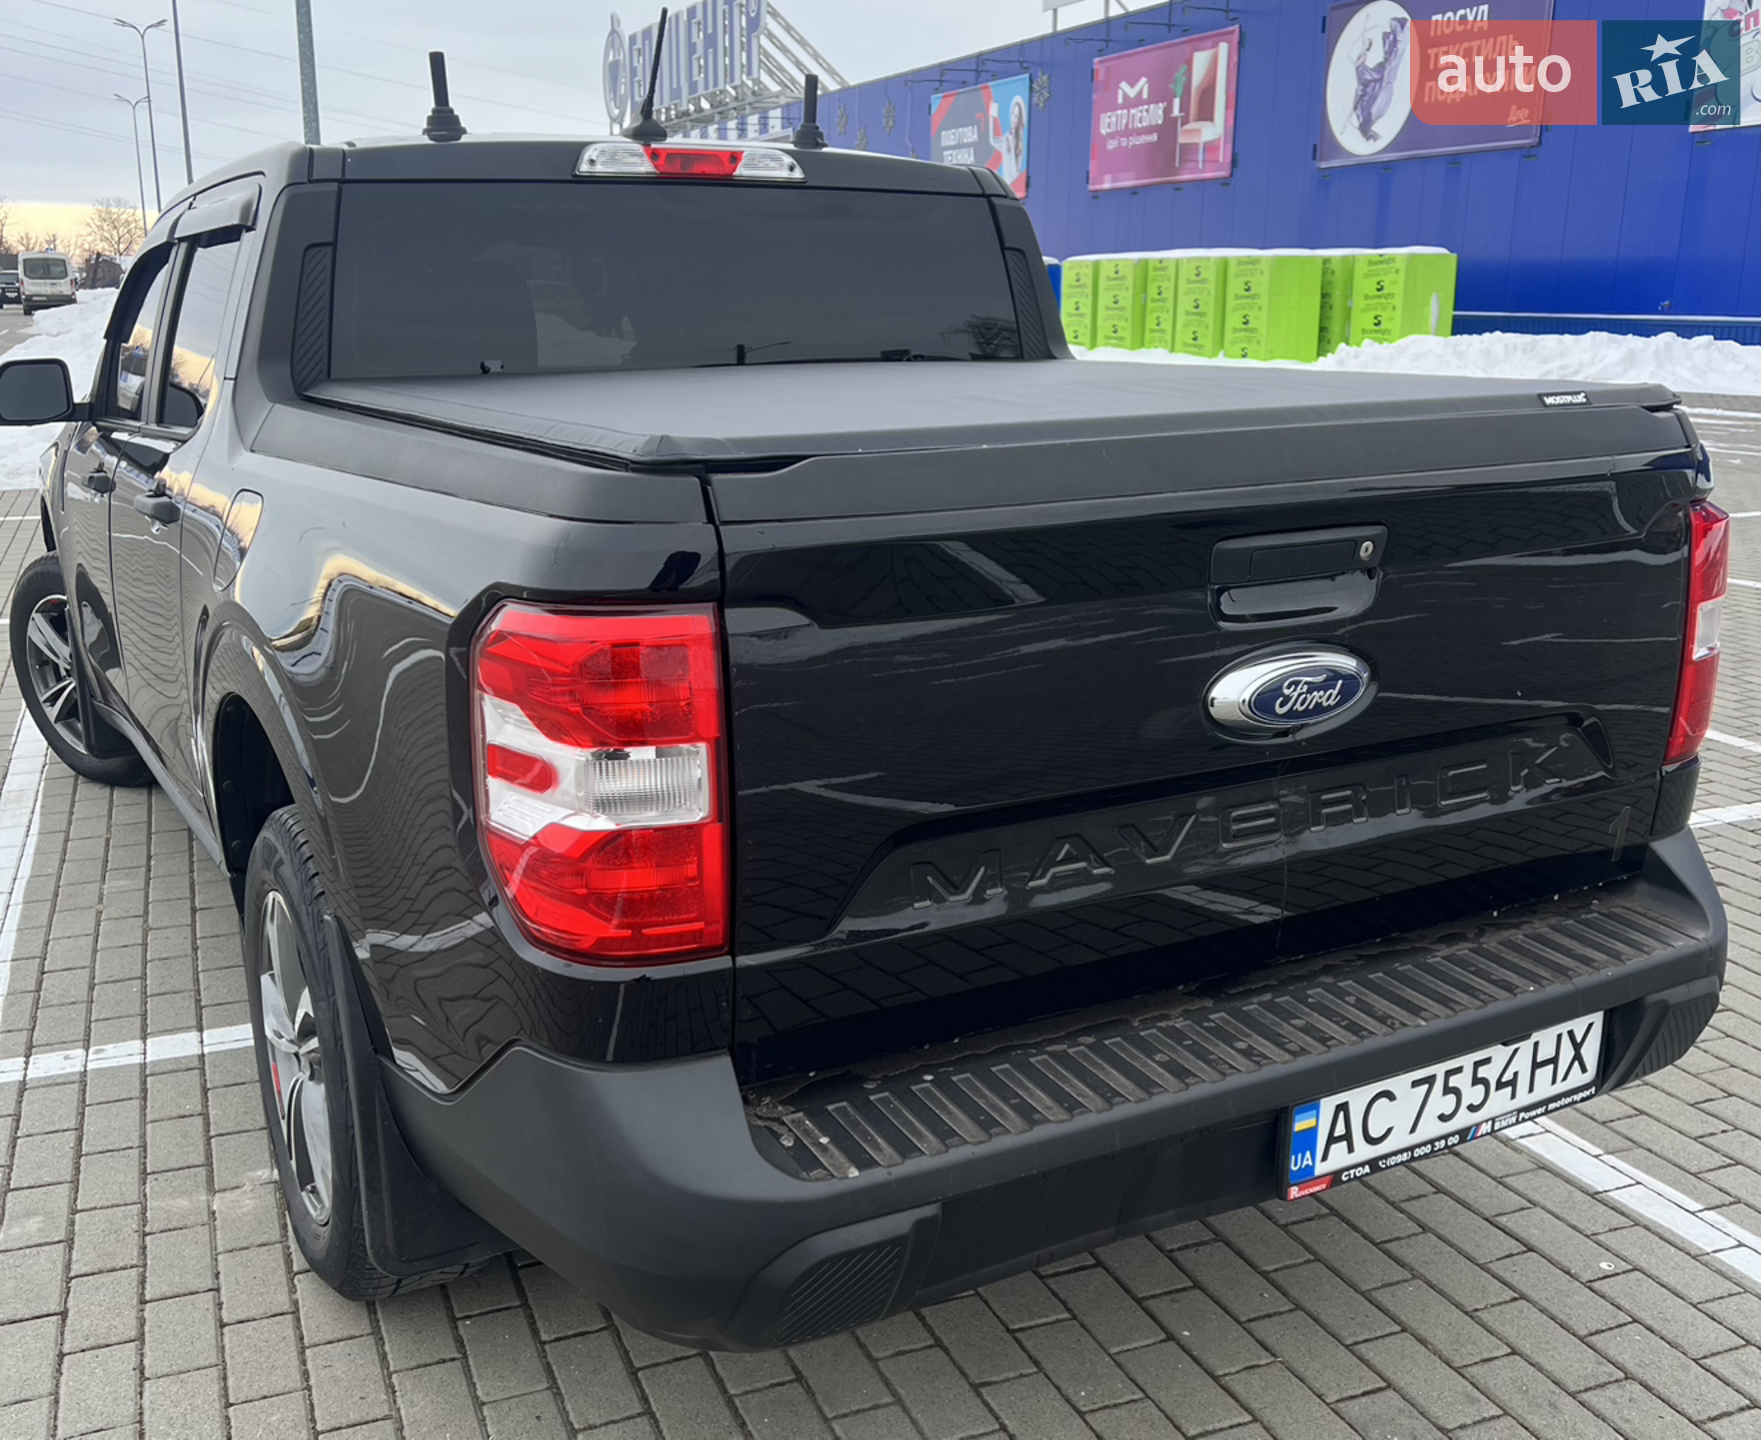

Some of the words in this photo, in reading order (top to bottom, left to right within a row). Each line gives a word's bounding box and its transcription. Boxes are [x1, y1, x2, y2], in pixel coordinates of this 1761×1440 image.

[1430, 4, 1489, 37] ПОСУД
[1100, 108, 1128, 135] ЦЕНТР
[1275, 674, 1343, 714] Ford
[910, 735, 1577, 909] MAVERICK
[1320, 1089, 1397, 1163] AC
[1409, 1046, 1520, 1135] 7554
[1527, 1021, 1595, 1095] HX
[1494, 1115, 1517, 1131] BMW
[1518, 1106, 1547, 1122] Power
[1547, 1085, 1596, 1111] motorsport
[1291, 1150, 1313, 1171] UA
[1386, 1151, 1411, 1167] (098)
[1413, 1146, 1432, 1159] 000
[1433, 1139, 1446, 1152] 39
[1447, 1134, 1460, 1147] 00
